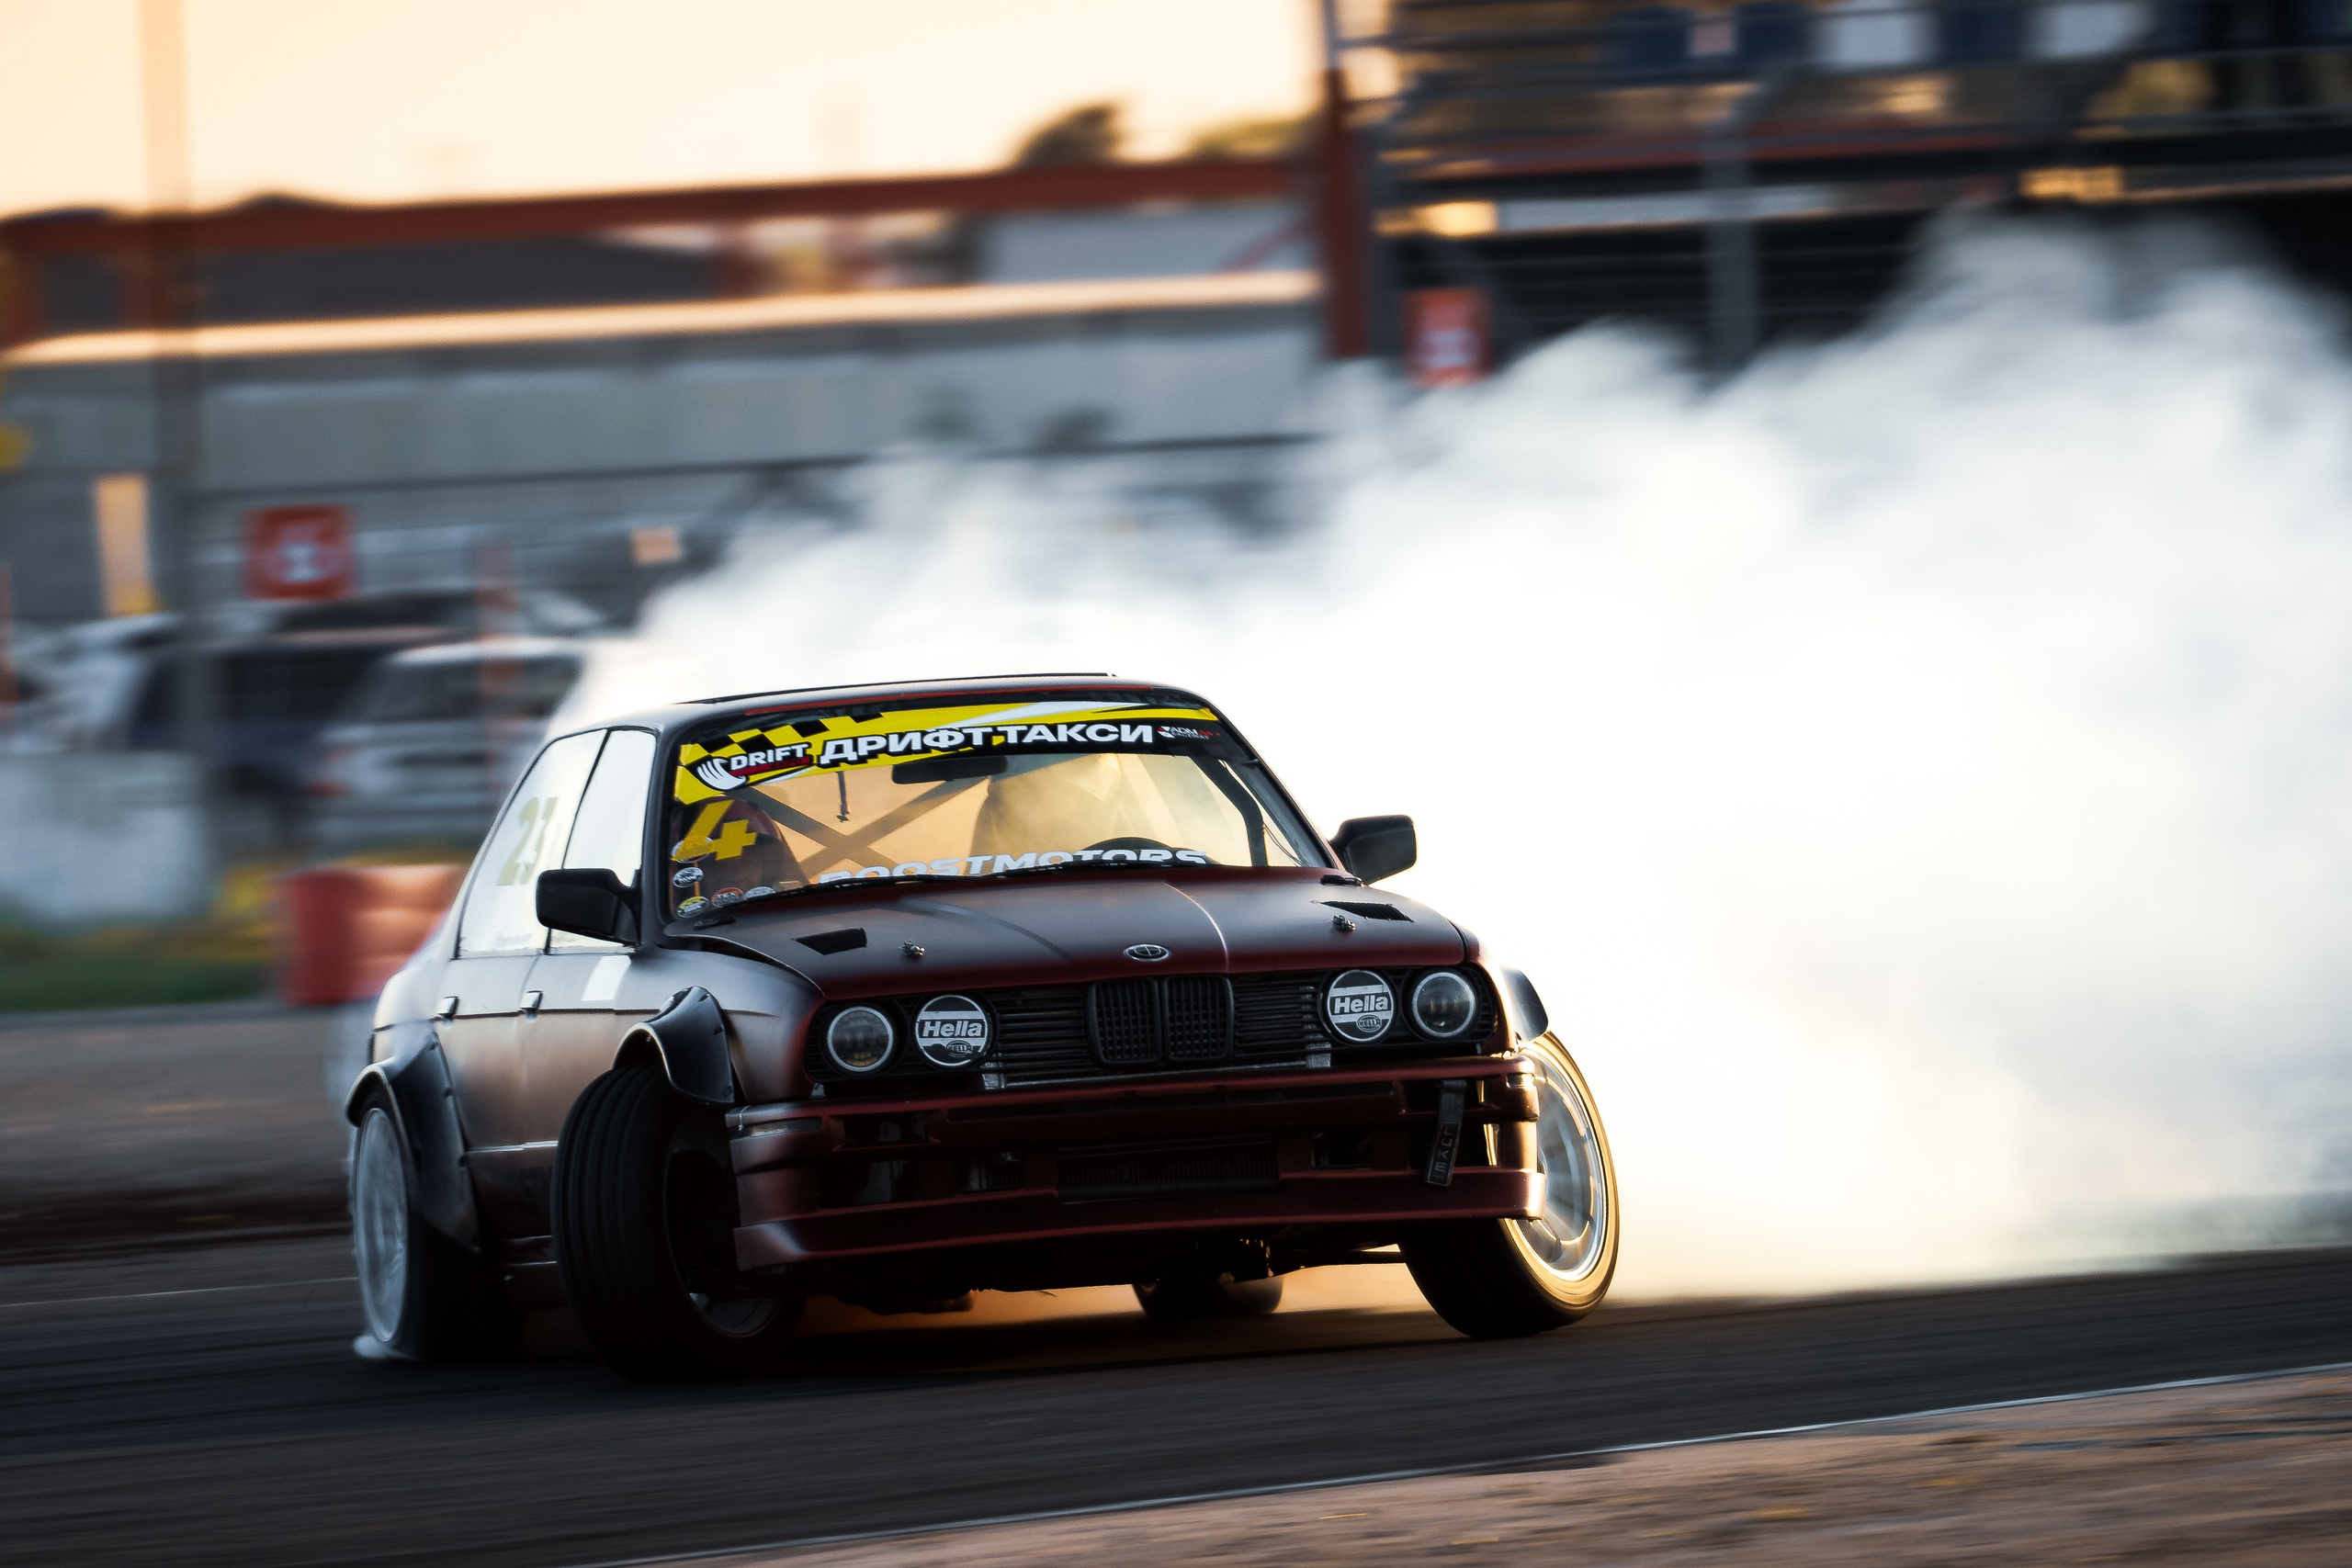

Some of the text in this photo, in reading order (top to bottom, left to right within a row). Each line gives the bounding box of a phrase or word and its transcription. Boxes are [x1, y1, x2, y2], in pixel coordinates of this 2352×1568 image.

[730, 743, 808, 771] DRIFT
[671, 800, 757, 862] 4
[1334, 995, 1388, 1014] Hella
[922, 1021, 982, 1037] Hella
[1434, 1125, 1453, 1172] LUKE
